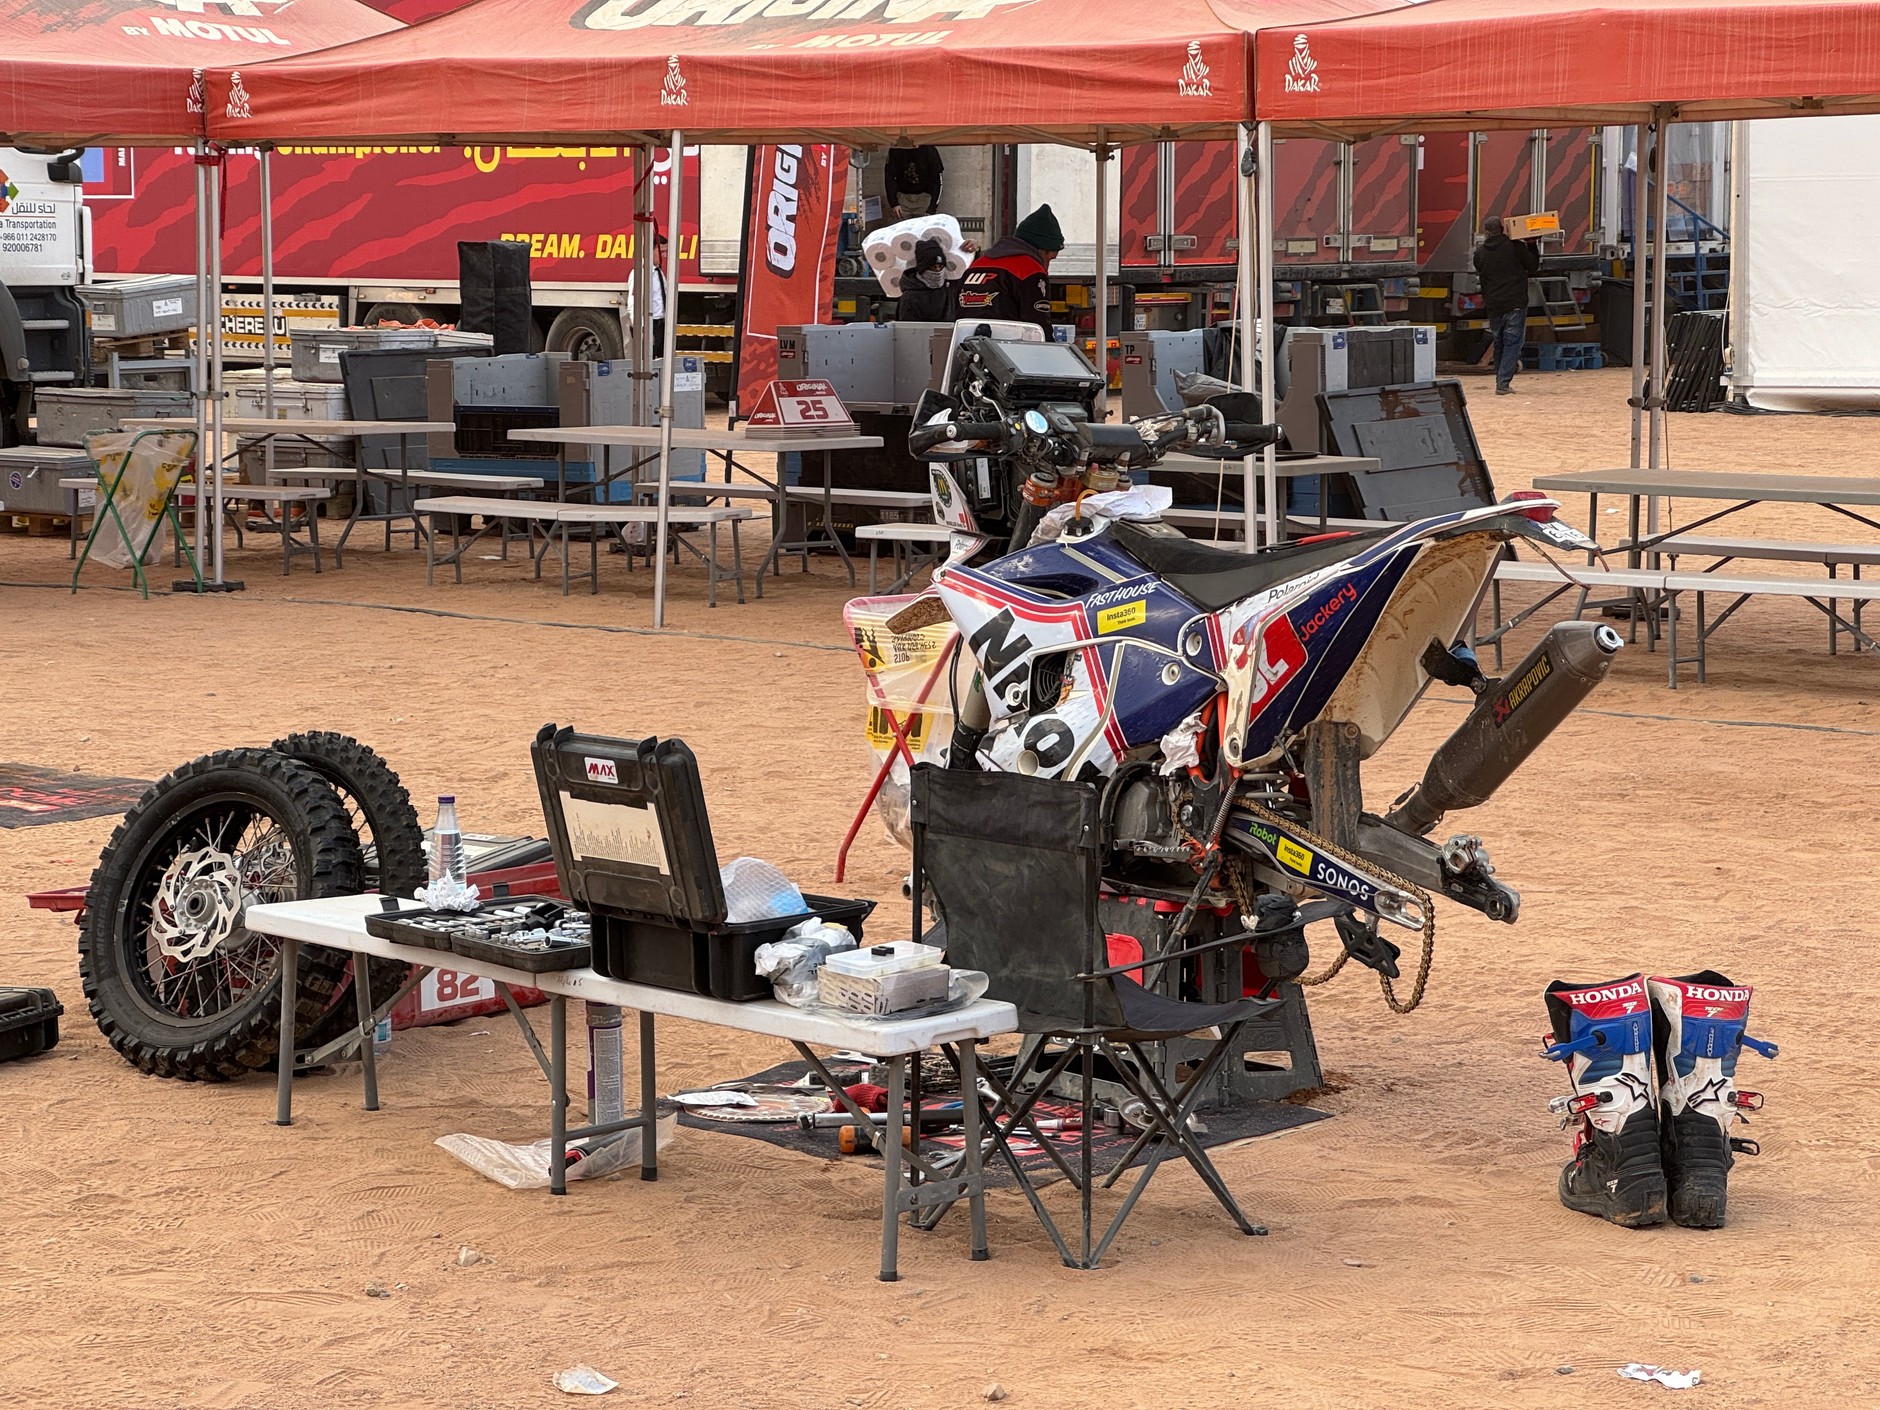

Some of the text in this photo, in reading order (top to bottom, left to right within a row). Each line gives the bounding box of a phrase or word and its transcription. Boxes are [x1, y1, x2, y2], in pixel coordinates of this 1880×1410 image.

[121, 17, 291, 45] BY MOTUL
[788, 31, 954, 48] MOTUL
[1178, 79, 1212, 97] DAKAR
[1285, 74, 1320, 93] DAKAR
[661, 89, 688, 106] DAKAR
[226, 103, 252, 118] DAKAR
[5, 219, 57, 230] Transportation
[16, 233, 28, 241] 011
[30, 233, 57, 241] 2428170
[2, 243, 43, 252] 920006781
[221, 316, 286, 335] HEREU
[1125, 345, 1135, 354] TP
[796, 400, 829, 420] 25
[1085, 582, 1162, 609] FASTHOUSE
[1107, 607, 1136, 621] Insta360
[1300, 583, 1358, 642] Jackery
[588, 762, 615, 777] MAX
[1284, 844, 1305, 861] Insta360
[1317, 863, 1370, 901] SONOS
[436, 968, 480, 1002] 82
[1569, 982, 1643, 1005] HONDA
[1685, 985, 1750, 1002] HONDA
[1625, 1006, 1635, 1014] 7
[1610, 1184, 1618, 1193] 7
